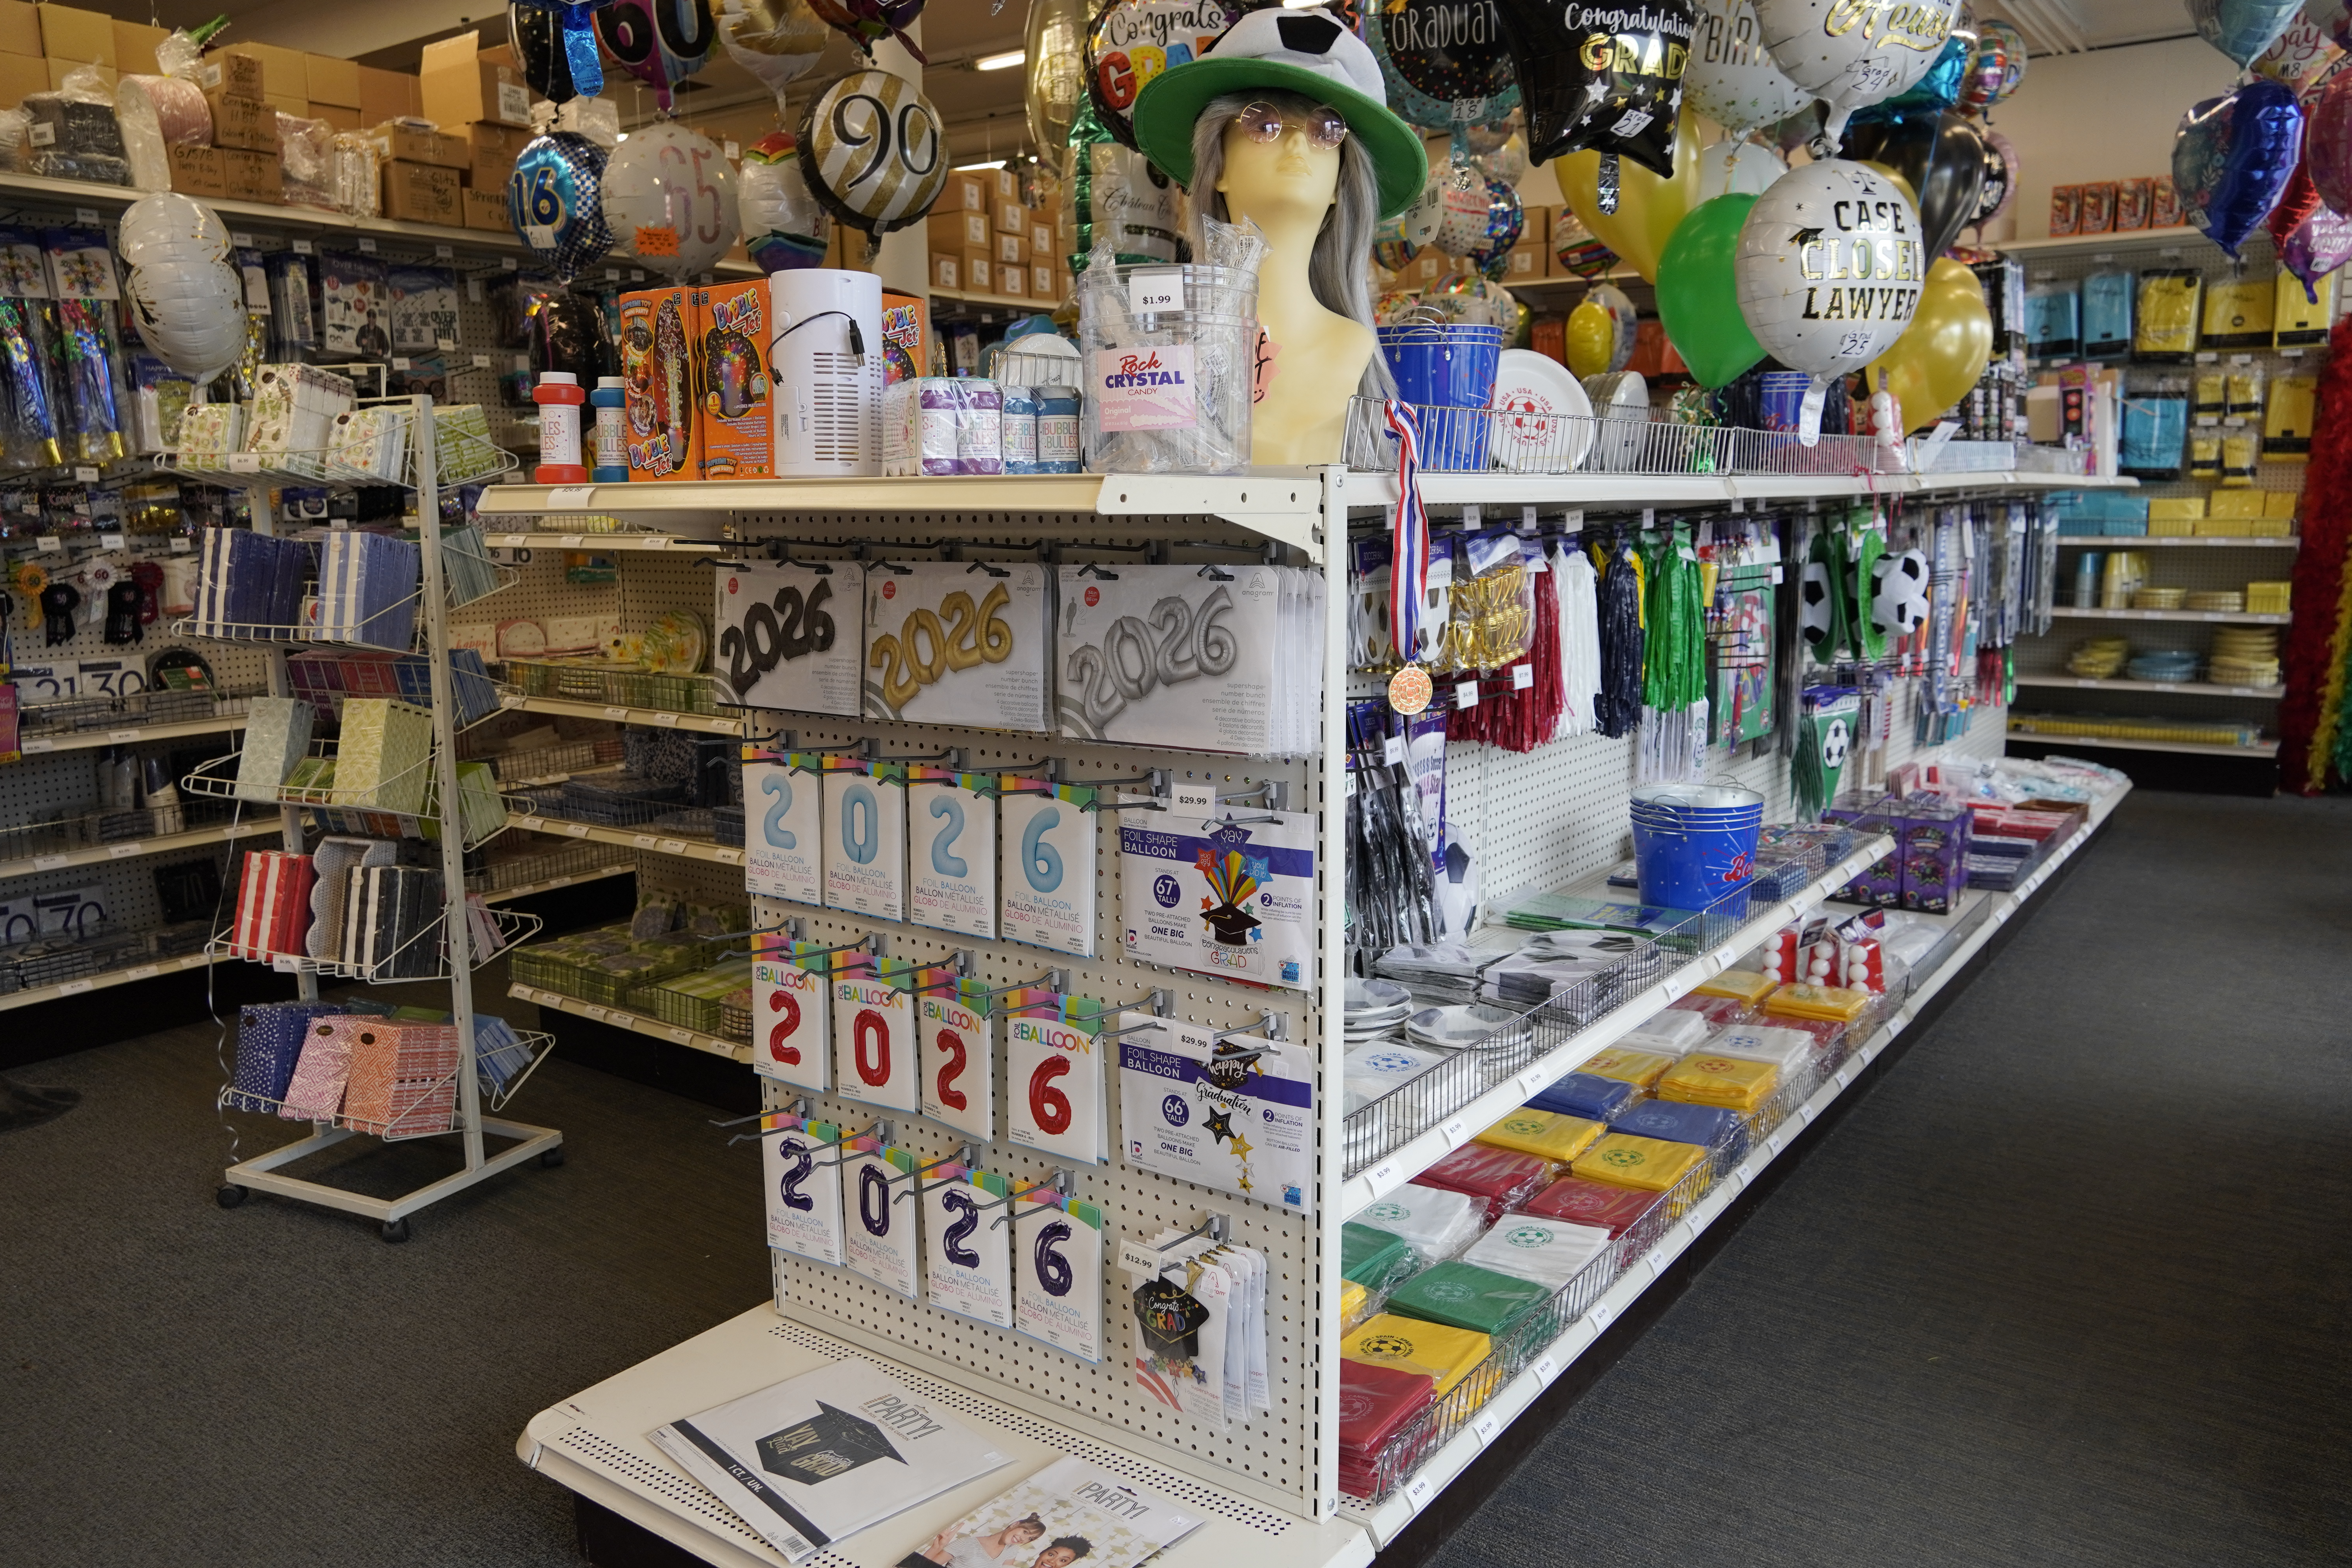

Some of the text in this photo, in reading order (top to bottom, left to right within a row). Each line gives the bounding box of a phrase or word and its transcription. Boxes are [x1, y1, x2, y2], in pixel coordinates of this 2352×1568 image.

[1111, 1, 1222, 47] Congrats
[1580, 32, 1688, 80] GRAD
[1863, 66, 1891, 76] Grad
[1852, 73, 1884, 91] 24
[1453, 106, 1478, 119] 18
[1614, 119, 1635, 136] 21
[833, 94, 938, 189] 90
[514, 167, 563, 230] 16
[1834, 201, 1905, 234] CASE
[715, 290, 758, 328] BUBBLE
[1143, 296, 1171, 305] $1.99
[1802, 288, 1916, 321] LAWYER
[737, 312, 760, 334] Jet
[1842, 340, 1868, 355] 25
[1120, 351, 1162, 376] Rock
[1105, 371, 1184, 388] CRYSTAL
[1105, 406, 1131, 416] Original
[1500, 393, 1511, 405] USA
[1540, 396, 1552, 411] USA
[960, 431, 993, 445] BULLES
[1047, 436, 1077, 448] BULLES
[630, 434, 669, 467] BUBBLE
[649, 456, 671, 473] Jet
[707, 458, 726, 467] SUPREME
[720, 577, 835, 696] 2026
[871, 582, 1012, 711] 2026
[1067, 585, 1236, 730] 2026
[1431, 756, 1442, 771] Soccer
[1430, 774, 1441, 795] Star
[1180, 796, 1207, 805] $29.99
[761, 773, 796, 850] 2
[842, 784, 878, 864] 0
[929, 795, 968, 878] 2
[1124, 831, 1178, 847] FOIL SHAPE
[1022, 807, 1063, 893] 6
[1125, 842, 1176, 858] BALLOON
[1015, 892, 1071, 911] FOIL BALLOON
[1158, 895, 1176, 905] TALL!
[1263, 895, 1270, 906] 2
[1005, 909, 1083, 933] GLOBO DE ALUMINIO
[1007, 900, 1080, 923] BALLON MÉTALLISÉ
[1152, 926, 1184, 938] ONE BIG
[1211, 952, 1246, 968] GRAD
[769, 989, 801, 1067] 2
[854, 1009, 891, 1088] 0
[1021, 1023, 1089, 1054] BALLOON
[1181, 1035, 1207, 1047] $29.99
[937, 1027, 967, 1112] 2
[1208, 1060, 1247, 1078] happy
[1530, 1073, 1541, 1083] $3.99
[1029, 1053, 1071, 1135] 6
[1196, 1082, 1251, 1116] Graduation
[1450, 1123, 1461, 1133] $3.99
[780, 1136, 813, 1213] 2
[1377, 1167, 1391, 1178] $3.99
[859, 1163, 889, 1238] 0
[942, 1187, 979, 1270] 2
[1505, 1226, 1554, 1243] PORTUGAL PORTUGAL
[1035, 1219, 1072, 1297] 6
[1125, 1253, 1152, 1268] $12.99
[1149, 1297, 1179, 1318] Congrats
[1597, 1308, 1607, 1319] $3.99
[1146, 1310, 1185, 1331] GRAD
[1399, 1338, 1411, 1347] SPAIN
[1539, 1361, 1551, 1373] $3.99
[864, 1393, 893, 1405] unique
[868, 1396, 943, 1439] PARTY!
[784, 1423, 821, 1449] YAY
[877, 1419, 889, 1428] BOÎTE
[894, 1430, 910, 1441] CARTON
[1481, 1421, 1492, 1435] $3.99
[766, 1437, 798, 1454] grad
[790, 1454, 848, 1476] GRAD
[816, 1450, 854, 1466] Congrats
[732, 1468, 746, 1477] CT.
[747, 1479, 763, 1493] UN.
[1073, 1480, 1093, 1493] unique
[1413, 1482, 1425, 1496] $3.99
[1077, 1483, 1149, 1519] PARTY!
